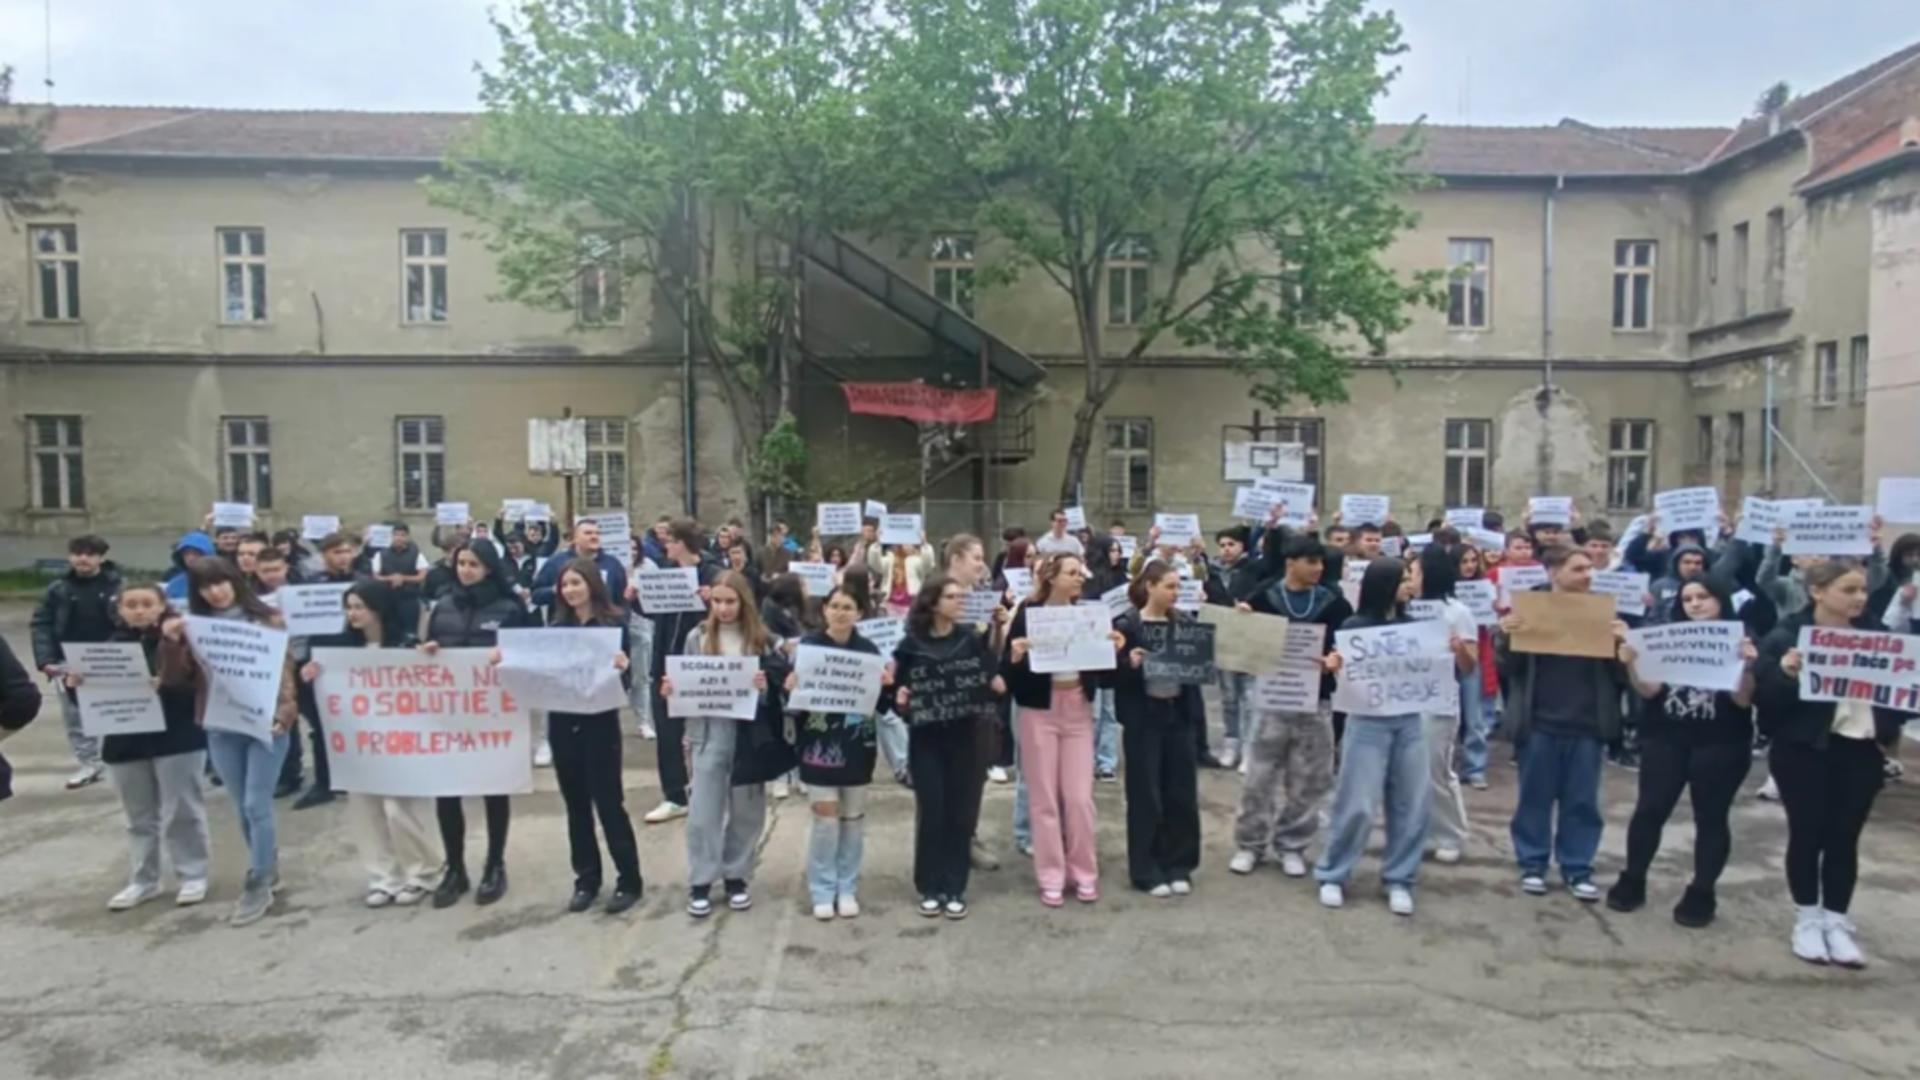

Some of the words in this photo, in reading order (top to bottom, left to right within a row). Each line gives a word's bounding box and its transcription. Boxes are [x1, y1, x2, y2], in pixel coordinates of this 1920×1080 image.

[728, 662, 743, 671] DE
[824, 653, 863, 667] VREAU
[1808, 652, 1828, 665] Nu
[1830, 654, 1850, 666] se
[1852, 652, 1890, 670] face
[1892, 657, 1916, 673] pe
[350, 663, 455, 688] MUTAREA
[721, 676, 728, 685] E
[735, 689, 750, 698] DE
[327, 694, 342, 716] E
[352, 694, 369, 717] O
